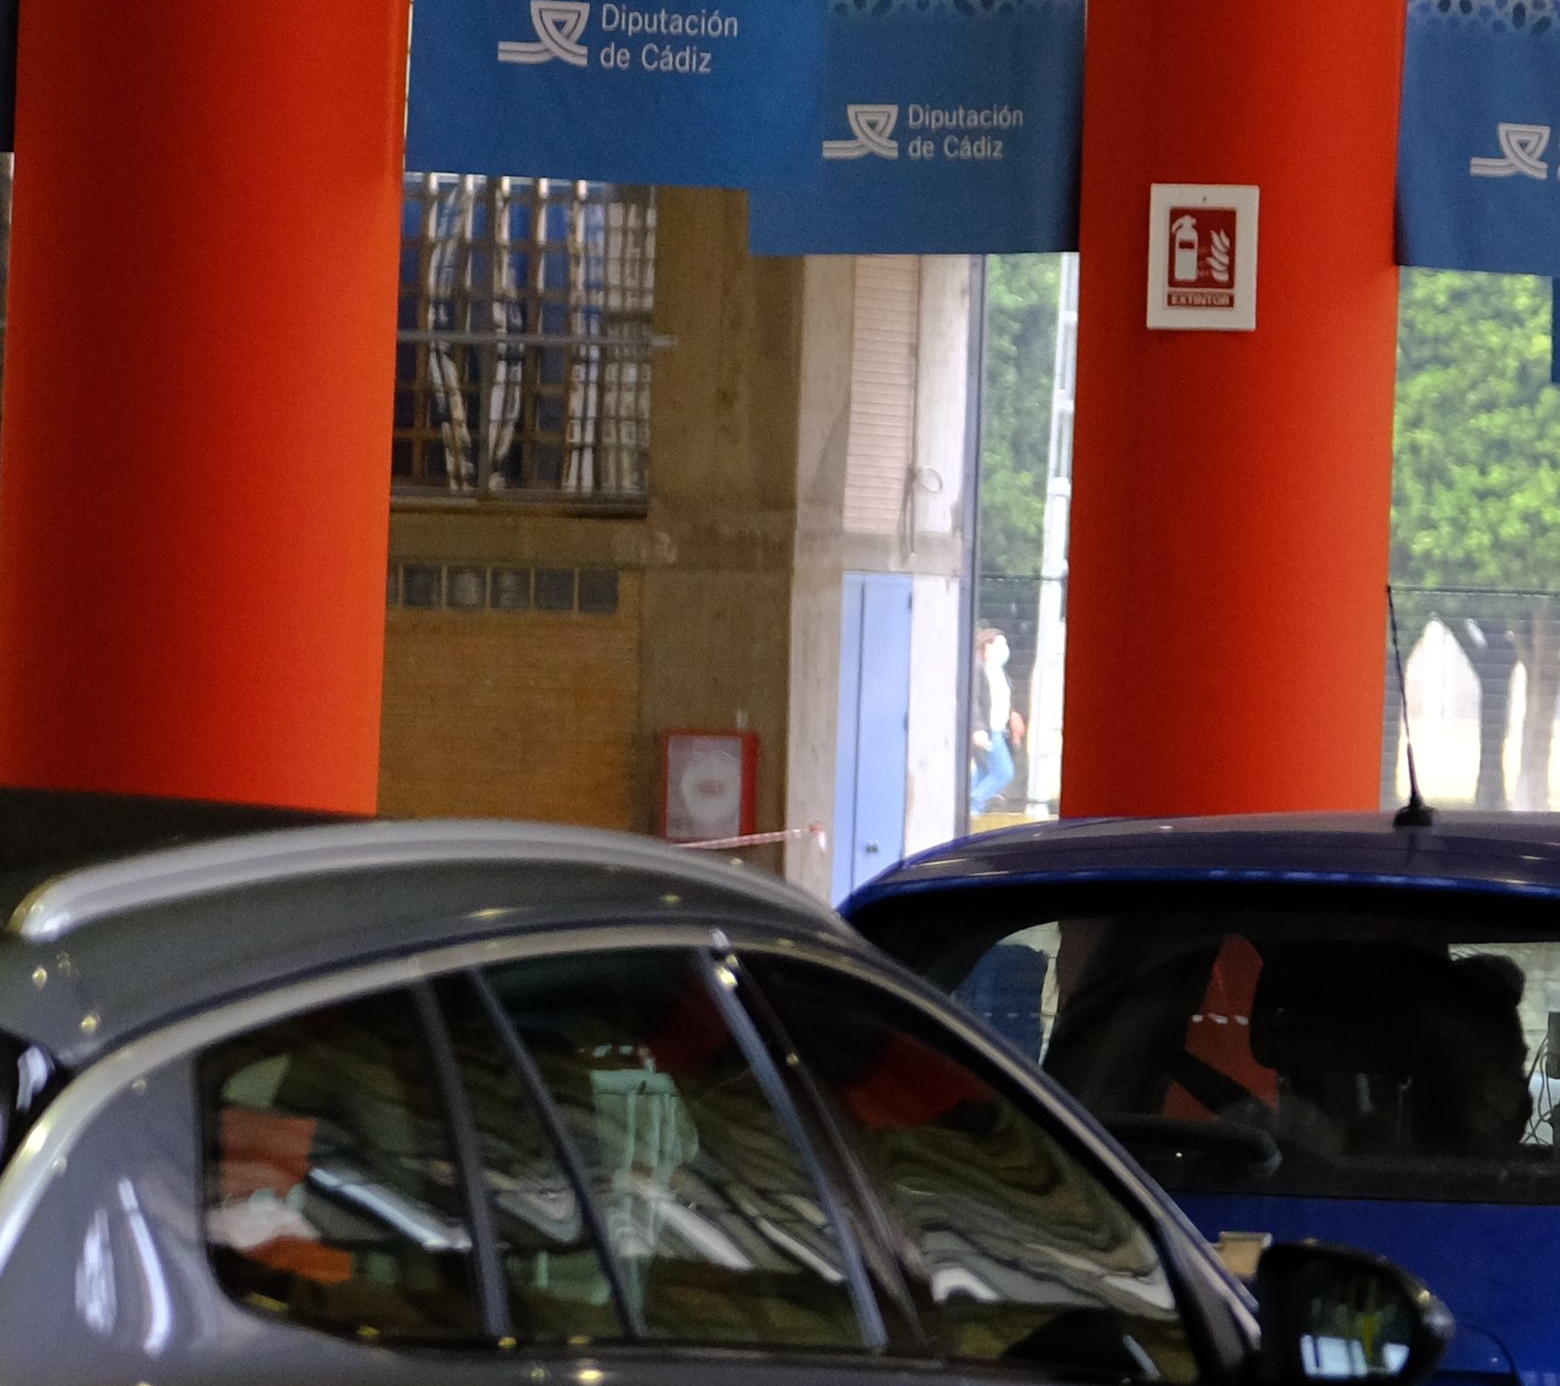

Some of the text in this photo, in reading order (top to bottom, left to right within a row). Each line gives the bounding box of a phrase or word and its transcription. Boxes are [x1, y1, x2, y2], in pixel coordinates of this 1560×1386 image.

[601, 3, 740, 37] Diputación
[600, 42, 712, 74] de Cádiz
[908, 104, 1024, 133] Diputación
[908, 135, 1004, 161] de Cádiz
[1171, 293, 1230, 305] EXTINTOR
